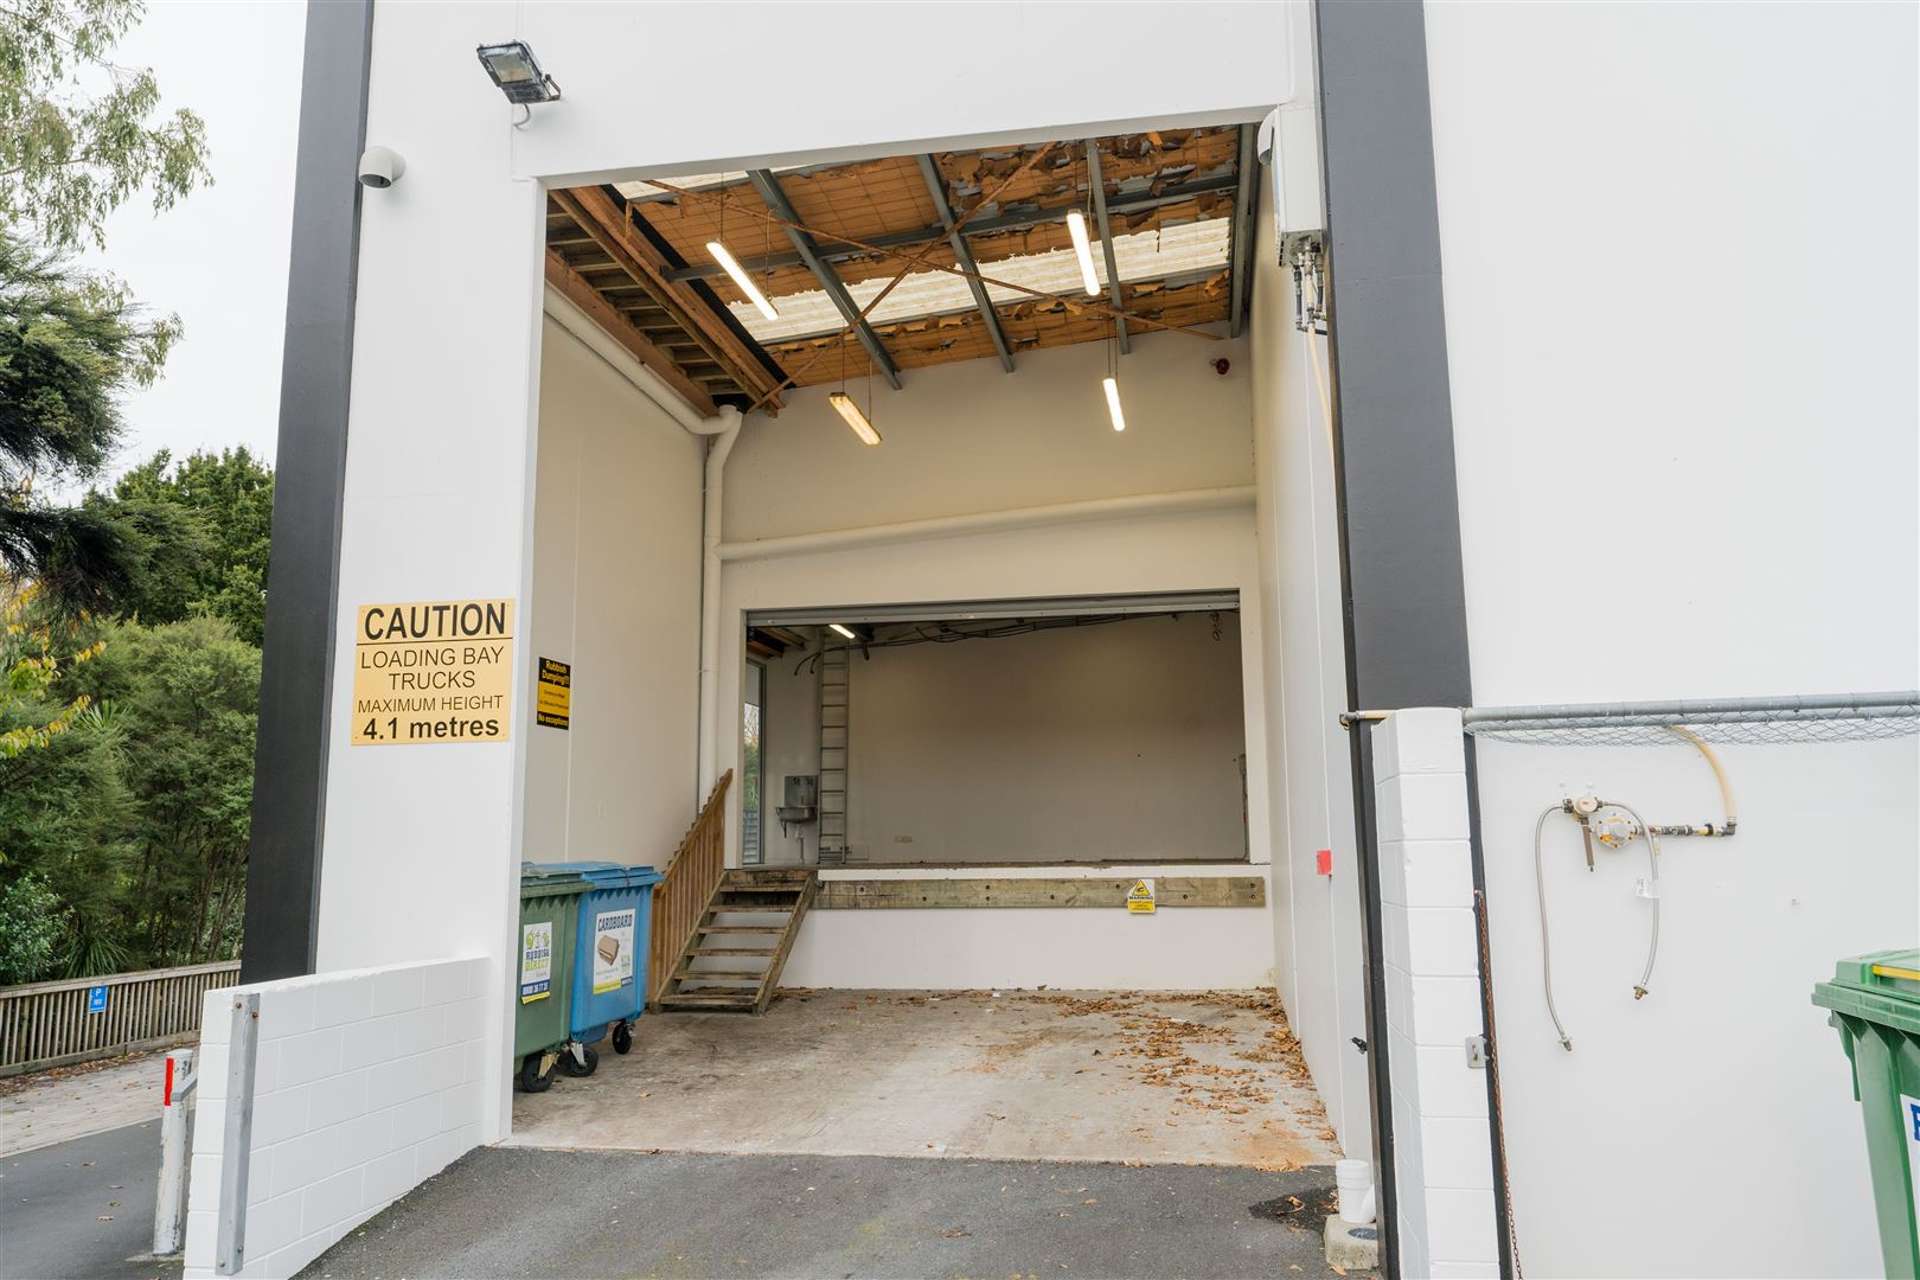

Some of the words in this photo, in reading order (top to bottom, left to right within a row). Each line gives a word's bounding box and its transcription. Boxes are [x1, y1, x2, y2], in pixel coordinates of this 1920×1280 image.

[364, 602, 506, 640] CAUTION
[361, 648, 456, 669] LOADING
[463, 646, 504, 665] BAY
[388, 670, 476, 690] TRUCKS
[358, 697, 436, 714] MAXIMUM
[441, 695, 503, 711] HEIGHT
[363, 717, 398, 740] 4.1
[409, 716, 500, 739] metres
[598, 913, 633, 932] CARDBOARD
